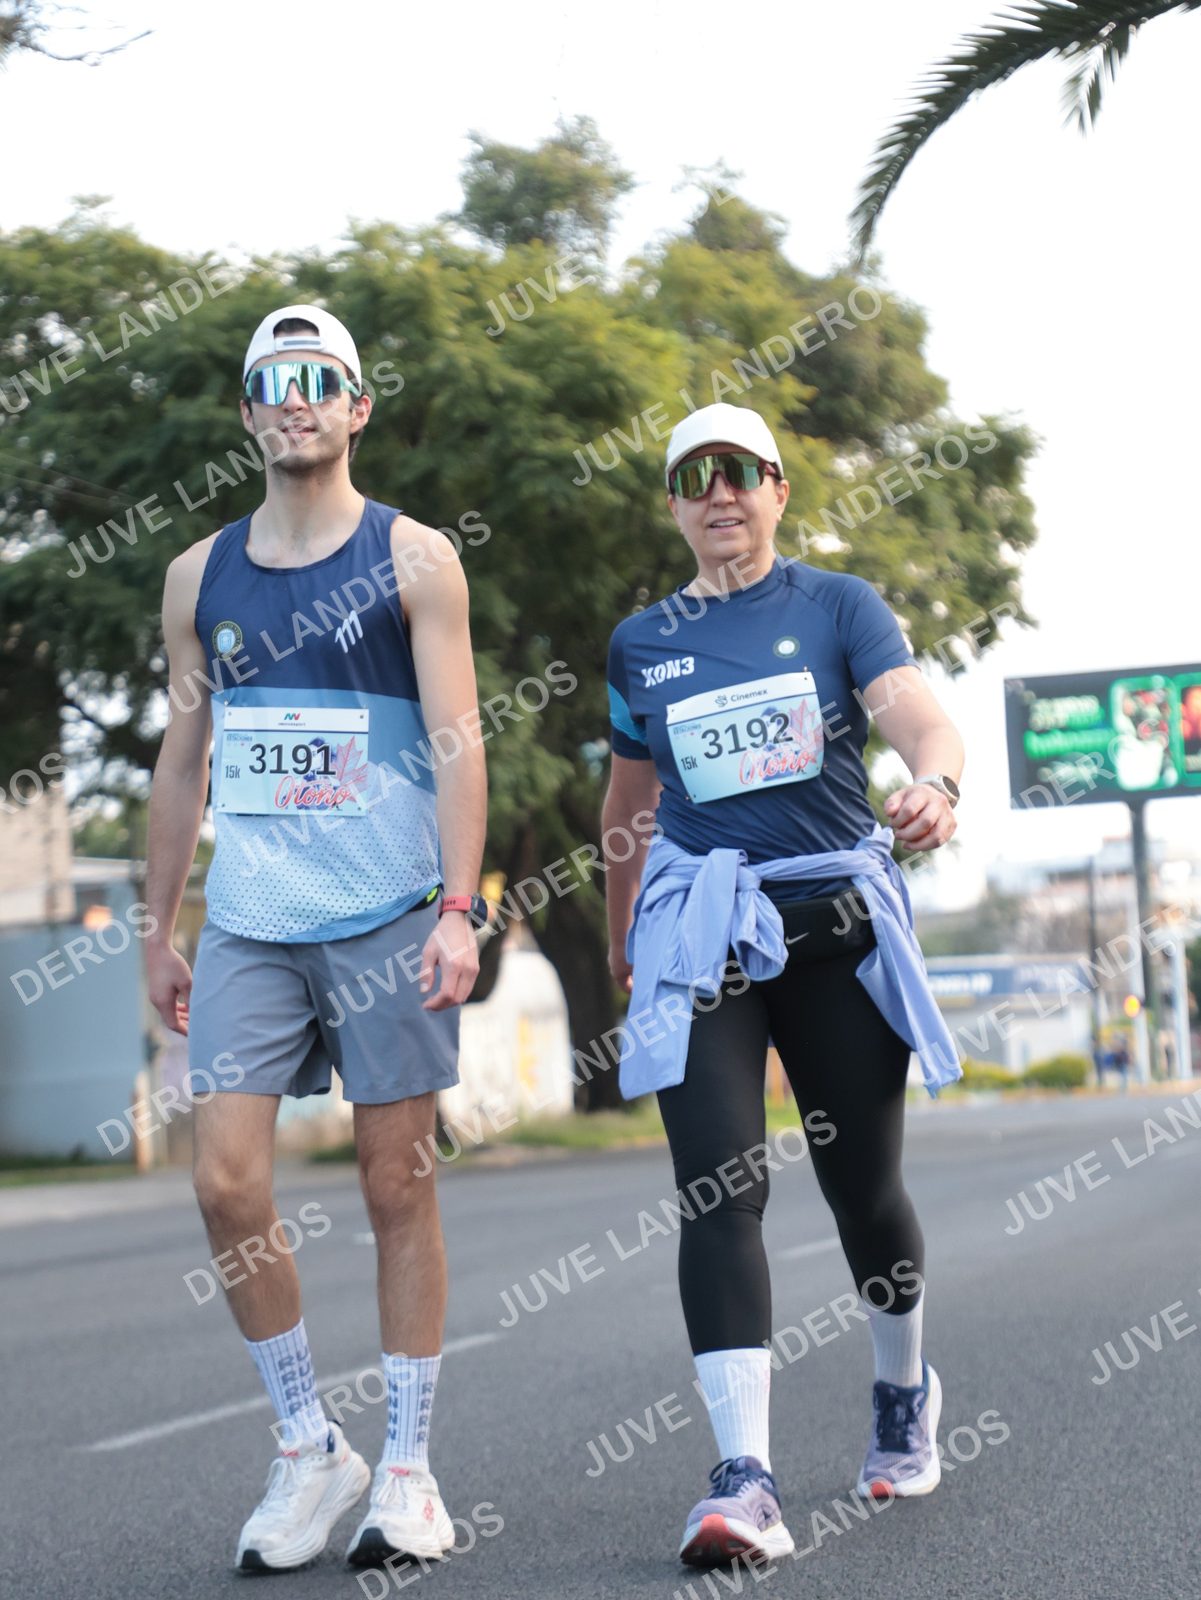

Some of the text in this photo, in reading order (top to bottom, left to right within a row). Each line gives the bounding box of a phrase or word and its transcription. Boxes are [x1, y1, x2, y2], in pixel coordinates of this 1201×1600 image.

[641, 657, 694, 688] XON3
[730, 689, 768, 702] Cinemex
[701, 713, 793, 760] 3192
[249, 743, 336, 775] 3191
[681, 756, 698, 771] 15k
[225, 765, 241, 778] 15k
